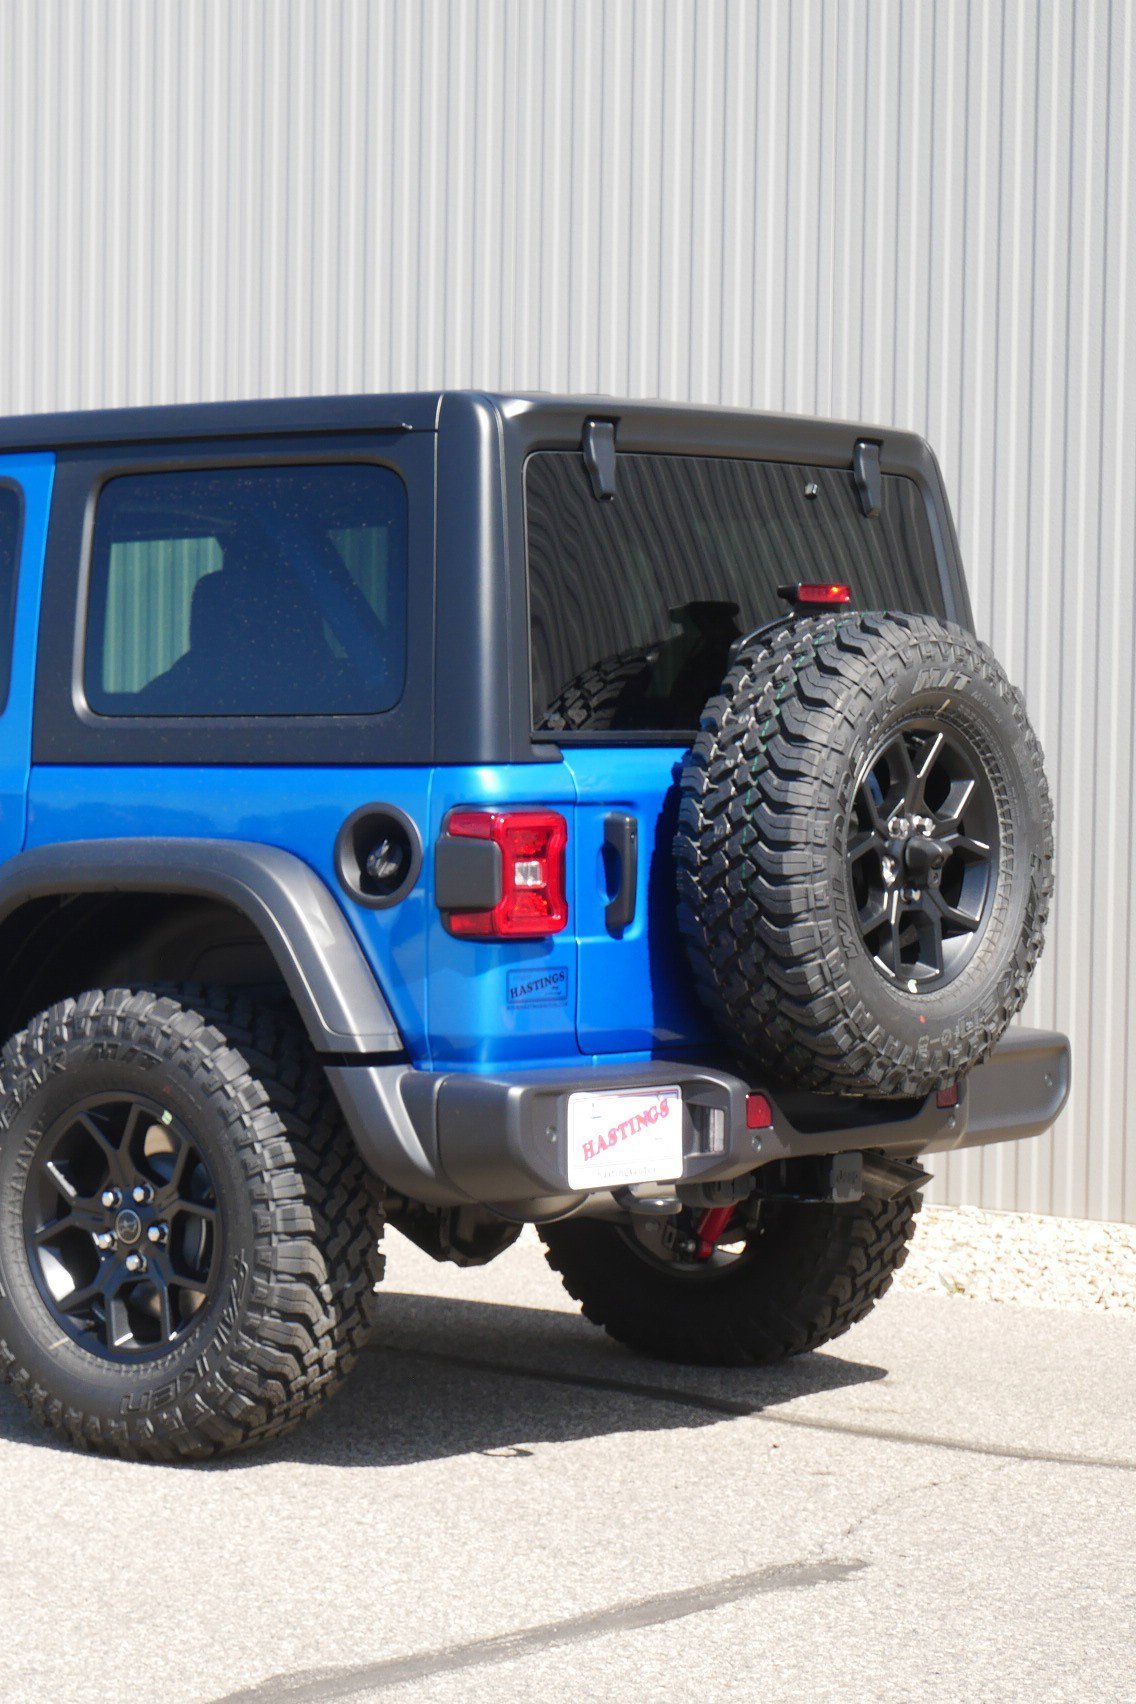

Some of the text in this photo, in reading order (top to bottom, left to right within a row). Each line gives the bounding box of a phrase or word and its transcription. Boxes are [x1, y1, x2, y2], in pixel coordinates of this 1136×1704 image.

[912, 667, 972, 694] M/T
[509, 971, 566, 999] HASTINGS
[582, 1098, 669, 1161] HASTINGS
